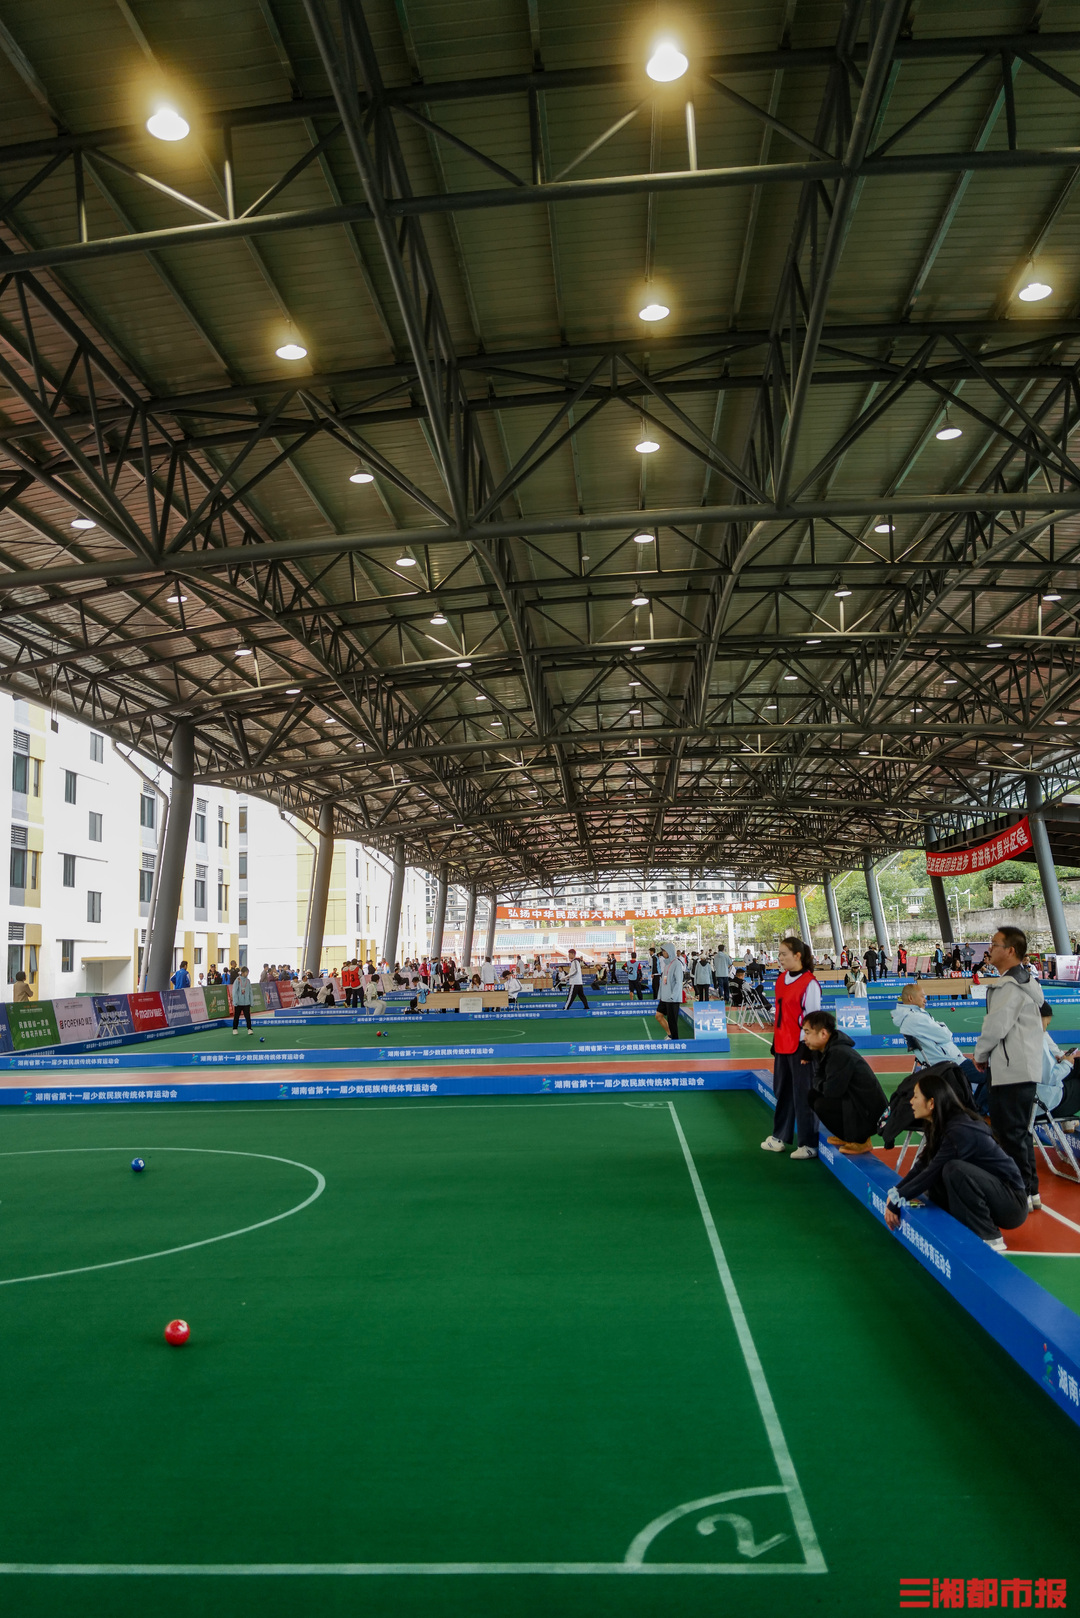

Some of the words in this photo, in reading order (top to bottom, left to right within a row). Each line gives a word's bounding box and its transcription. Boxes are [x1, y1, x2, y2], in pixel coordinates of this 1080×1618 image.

[508, 908, 626, 920] 弘扬中华民族伟大精神
[634, 899, 780, 918] 构筑中华民族共有精神家园
[776, 999, 783, 1029] 1
[697, 1018, 725, 1032] 11号
[839, 1015, 868, 1029] 12号
[388, 1048, 494, 1057] 湖南省第十一届少数民族传统体育运动会
[578, 1043, 688, 1052] 湖南省第十一届少数民族传统体育运动会
[17, 1058, 120, 1067] 湖南省第十一届少数民族传统体育运动会
[200, 1053, 305, 1062] 湖南省第十一届少数民族传统体育运动会
[291, 1083, 438, 1095] 湖南省第十一届少数民族传统体育运动会
[554, 1078, 705, 1090] 湖南省第十一届少数民族传统体育运动会
[35, 1090, 178, 1101] 湖南省第十一届少数民族传统体育运动会
[696, 1513, 790, 1558] 2
